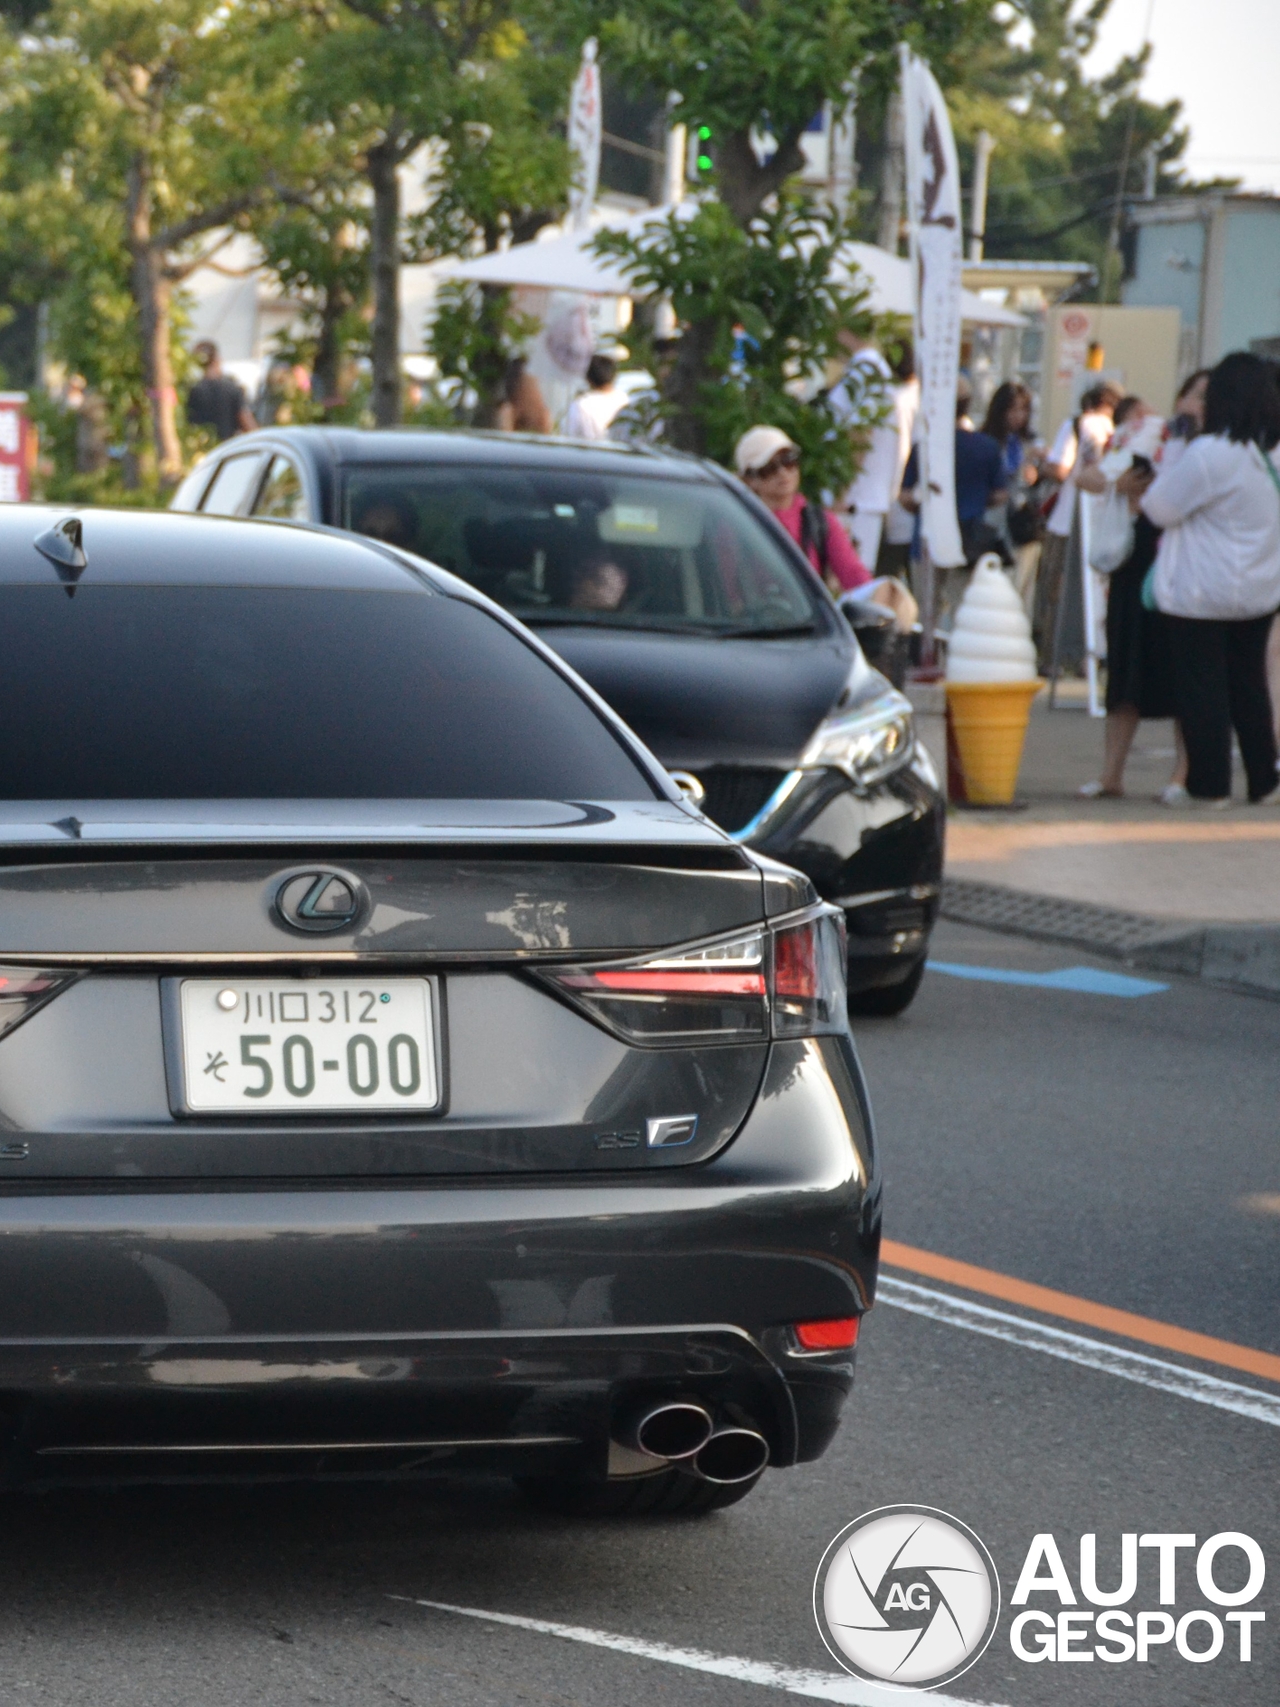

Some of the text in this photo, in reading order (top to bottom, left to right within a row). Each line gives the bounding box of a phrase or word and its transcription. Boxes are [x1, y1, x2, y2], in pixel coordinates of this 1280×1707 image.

[203, 1033, 421, 1098] そ 50-00
[594, 1130, 640, 1150] GS
